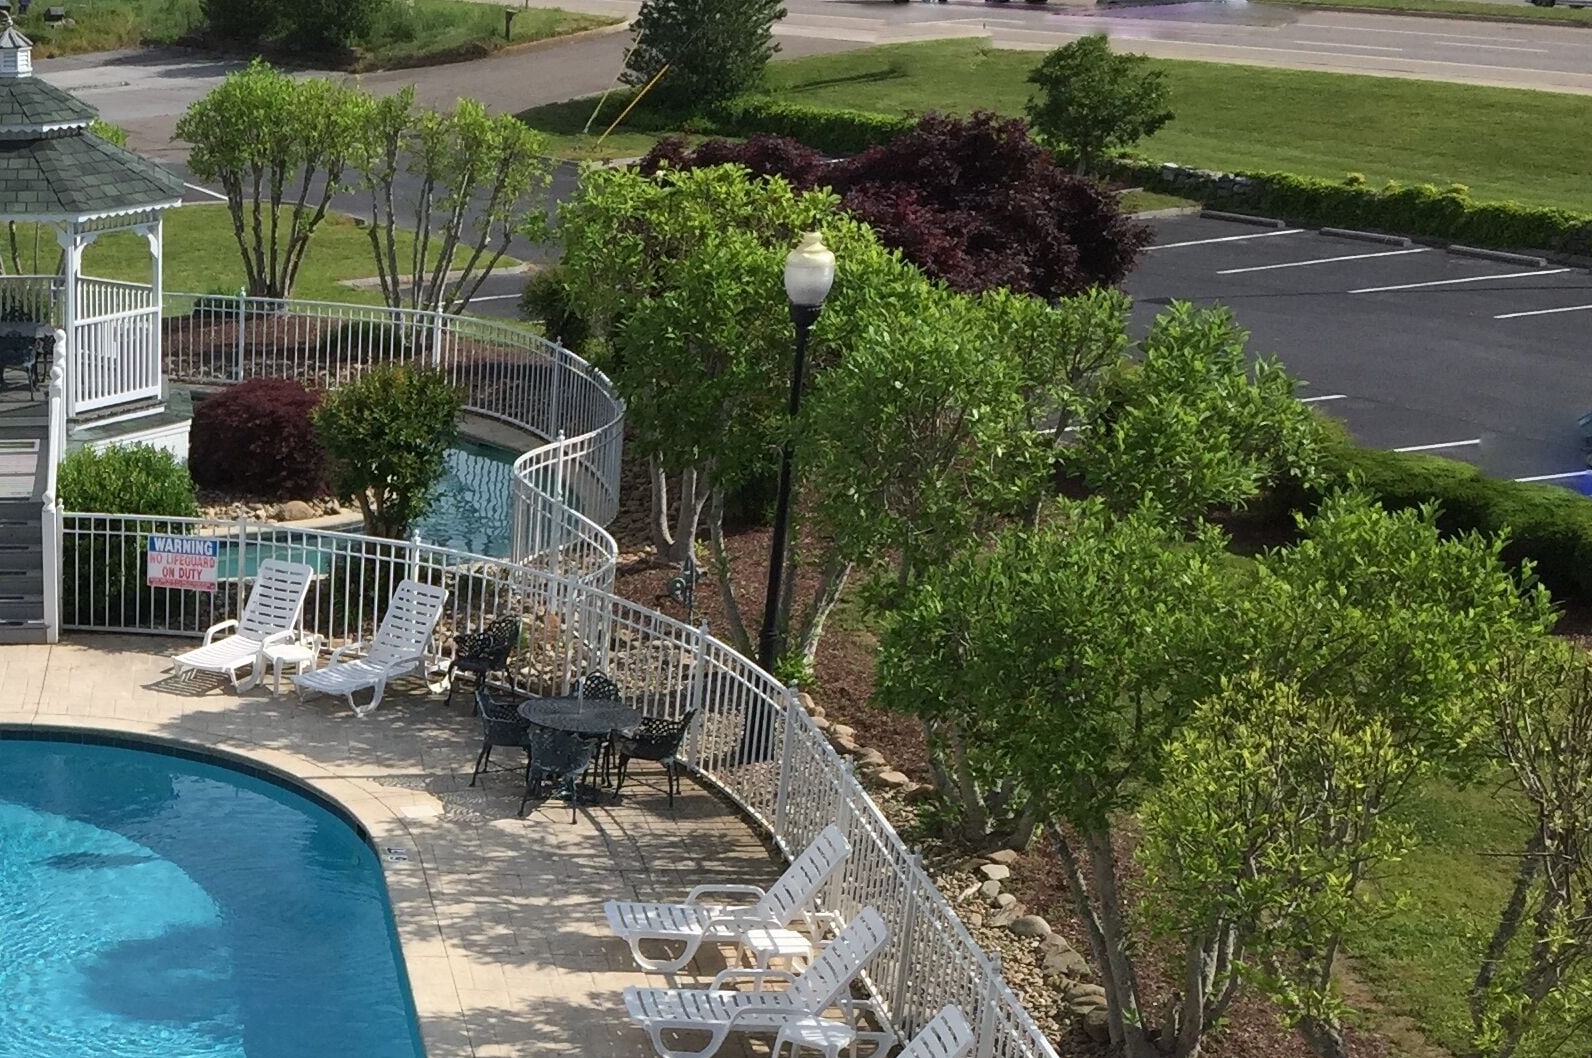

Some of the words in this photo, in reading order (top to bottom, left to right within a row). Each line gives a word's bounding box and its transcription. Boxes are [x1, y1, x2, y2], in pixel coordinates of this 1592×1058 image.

[154, 537, 213, 556] WARNING
[150, 553, 162, 564] NO
[167, 554, 215, 568] LIFEGUARD
[162, 566, 175, 578] ON
[178, 568, 203, 580] DUTY
